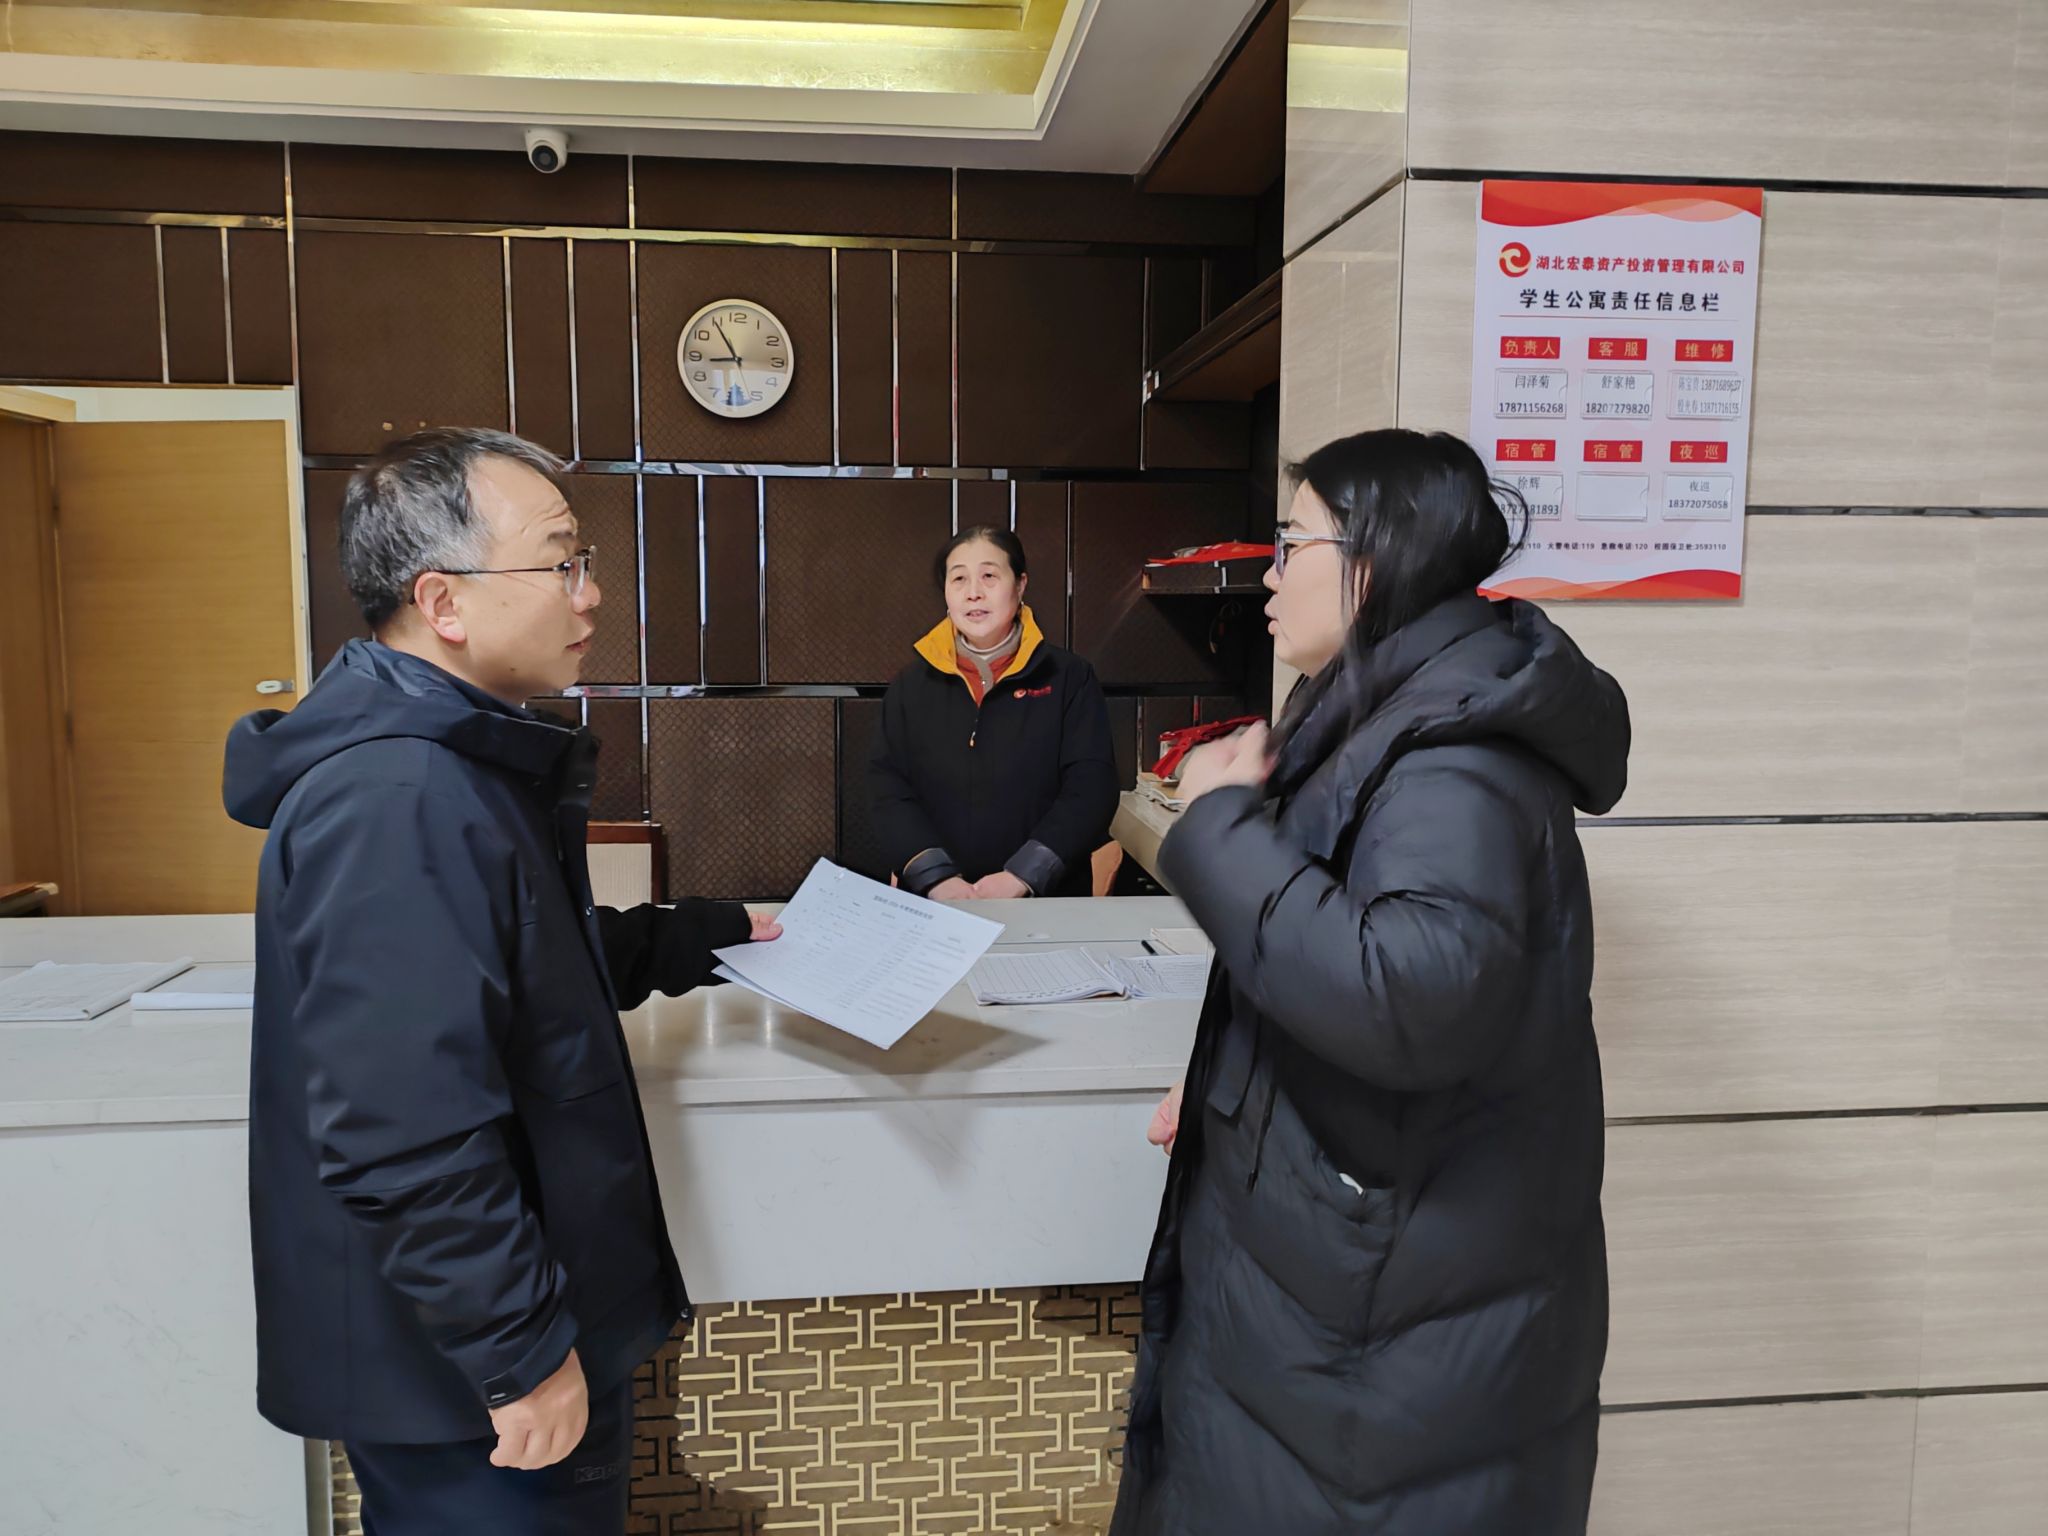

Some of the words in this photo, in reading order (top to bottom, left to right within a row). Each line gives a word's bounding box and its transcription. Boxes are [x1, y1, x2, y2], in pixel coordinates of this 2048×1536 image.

[1536, 255, 1745, 275] 湖北宏泰资产投资管理有限公司
[1519, 288, 1720, 312] 学生公寓责任信息栏
[728, 312, 748, 324] 12
[694, 329, 710, 341] 10
[765, 335, 780, 347] 2
[1504, 339, 1557, 357] 负责人
[1598, 341, 1640, 357] 客服
[1684, 342, 1728, 358] 维修
[688, 350, 703, 362] 9
[770, 357, 785, 369] 3
[693, 371, 707, 382] 8
[765, 376, 778, 388] 4
[707, 386, 721, 398] 7
[750, 390, 764, 401] 5
[1499, 403, 1564, 414] 17871156268
[1586, 403, 1650, 414] 18207279820
[1505, 443, 1546, 459] 宿管
[1593, 444, 1634, 459] 宿管
[1679, 444, 1720, 460] 夜巡
[1689, 480, 1710, 493] 夜巡
[1668, 499, 1729, 509] 18372075058
